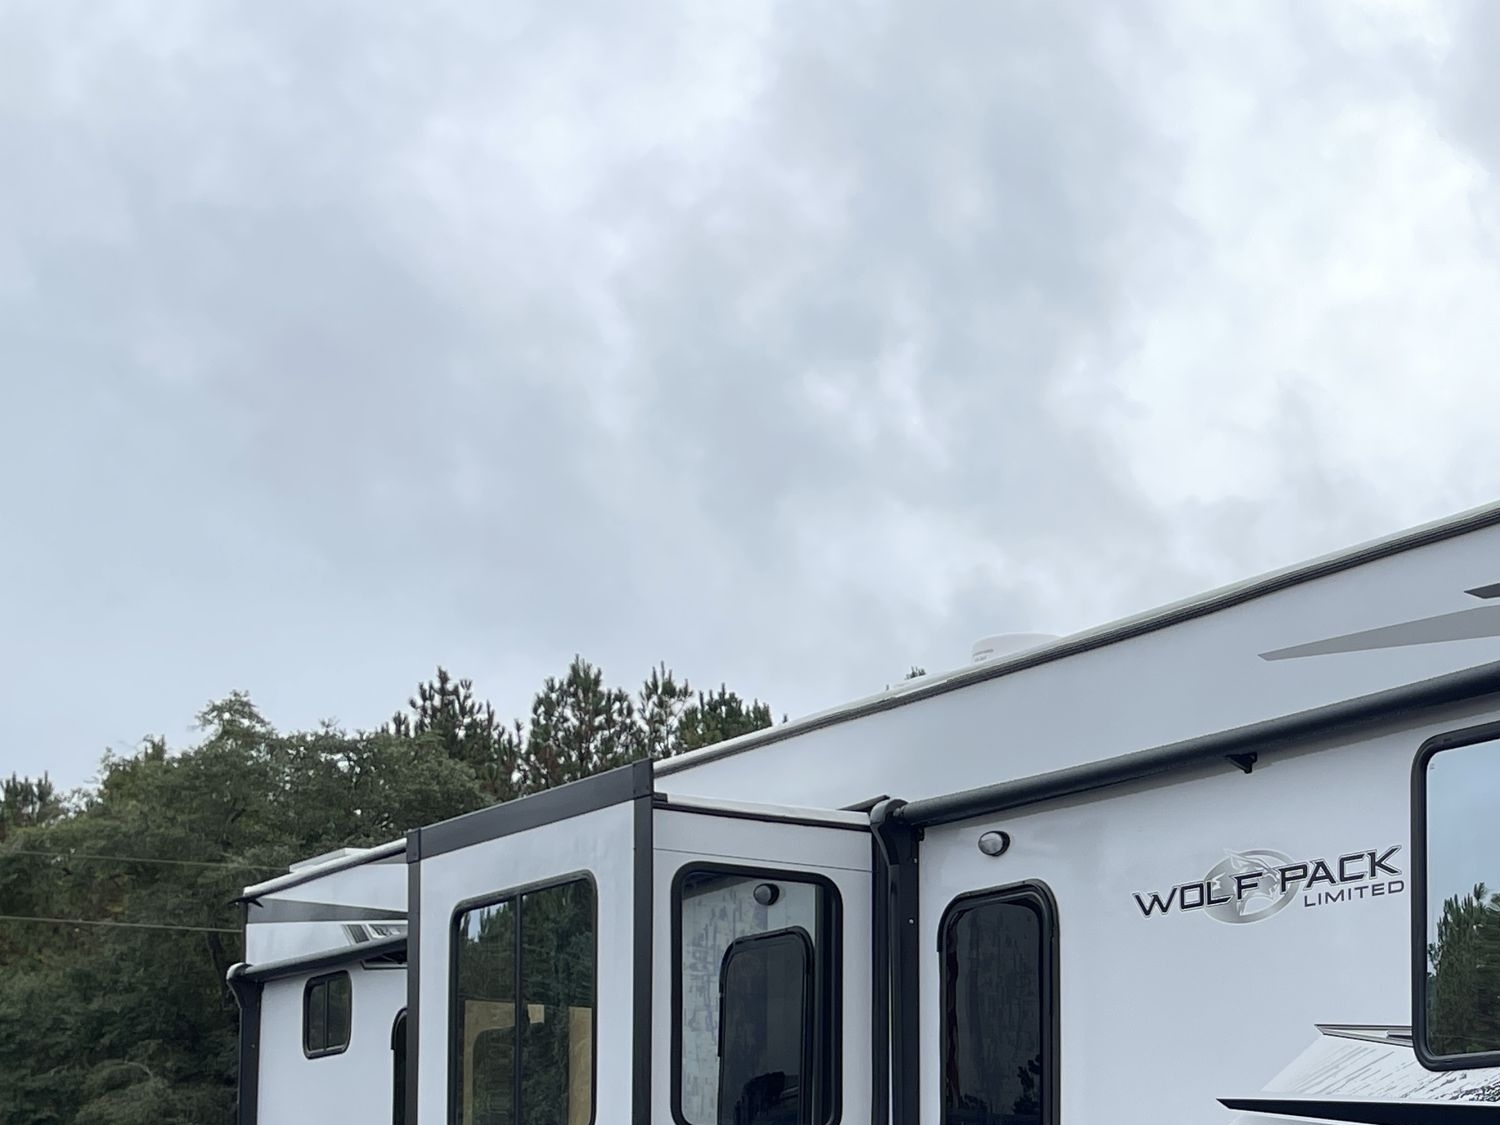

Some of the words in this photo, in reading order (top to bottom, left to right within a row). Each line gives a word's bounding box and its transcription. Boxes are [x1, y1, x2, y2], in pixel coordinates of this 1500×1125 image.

[1132, 871, 1264, 919] WOLF
[1277, 844, 1403, 895] PACK
[1304, 879, 1405, 907] LIMITED
